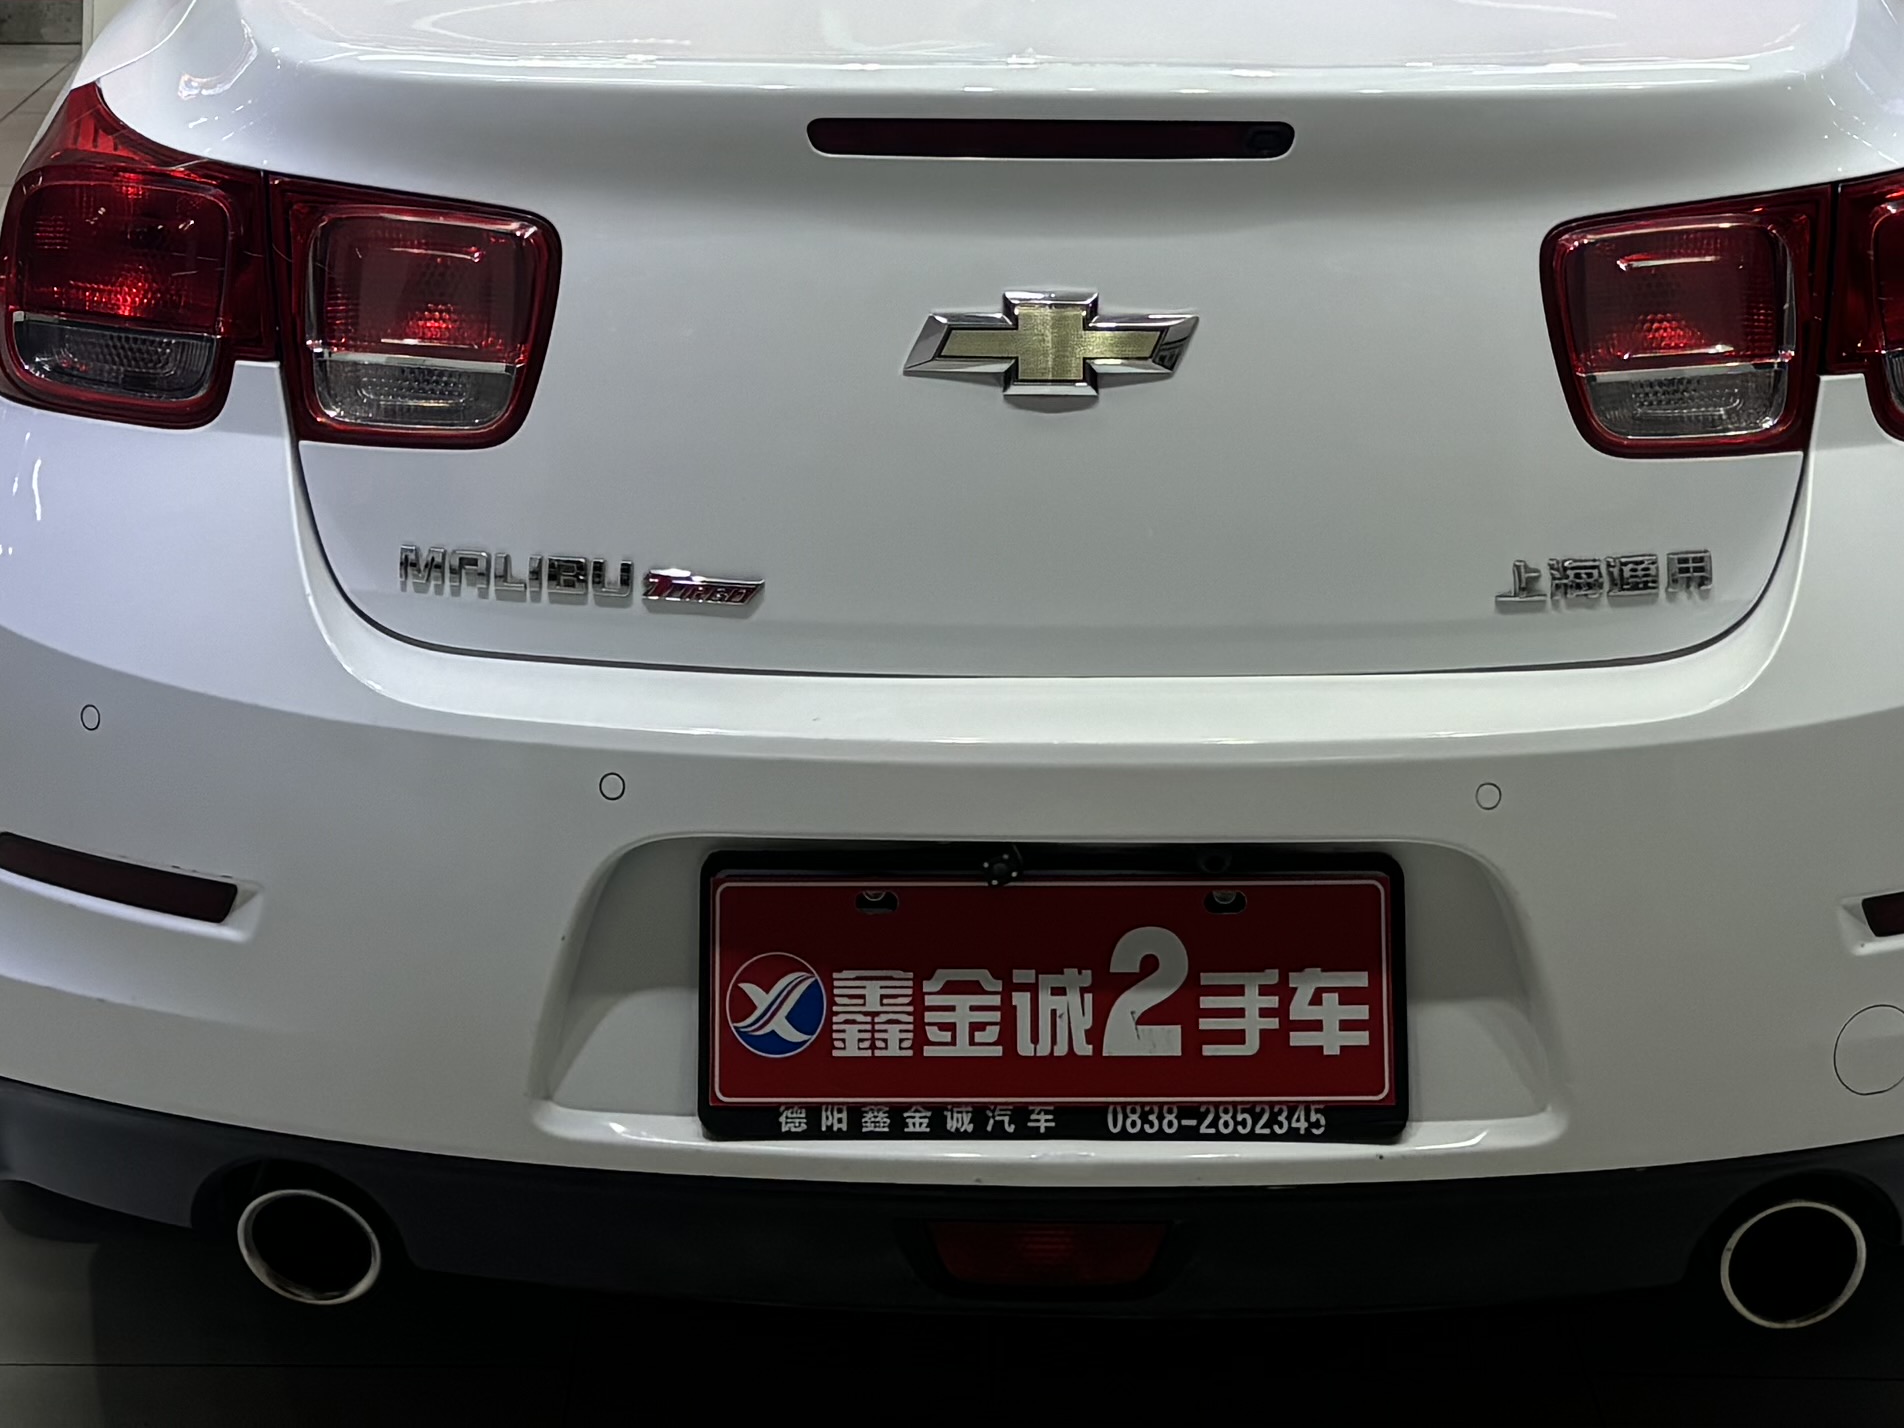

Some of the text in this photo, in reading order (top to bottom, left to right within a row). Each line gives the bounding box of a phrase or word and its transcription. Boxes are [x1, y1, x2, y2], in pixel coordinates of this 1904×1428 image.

[399, 544, 634, 597] MALIBU
[1495, 549, 1713, 601] 上海通用
[832, 926, 1370, 1057] 鑫金诚2手车
[778, 1104, 1328, 1136] 德阳鑫金诚汽车 0838-2852345
